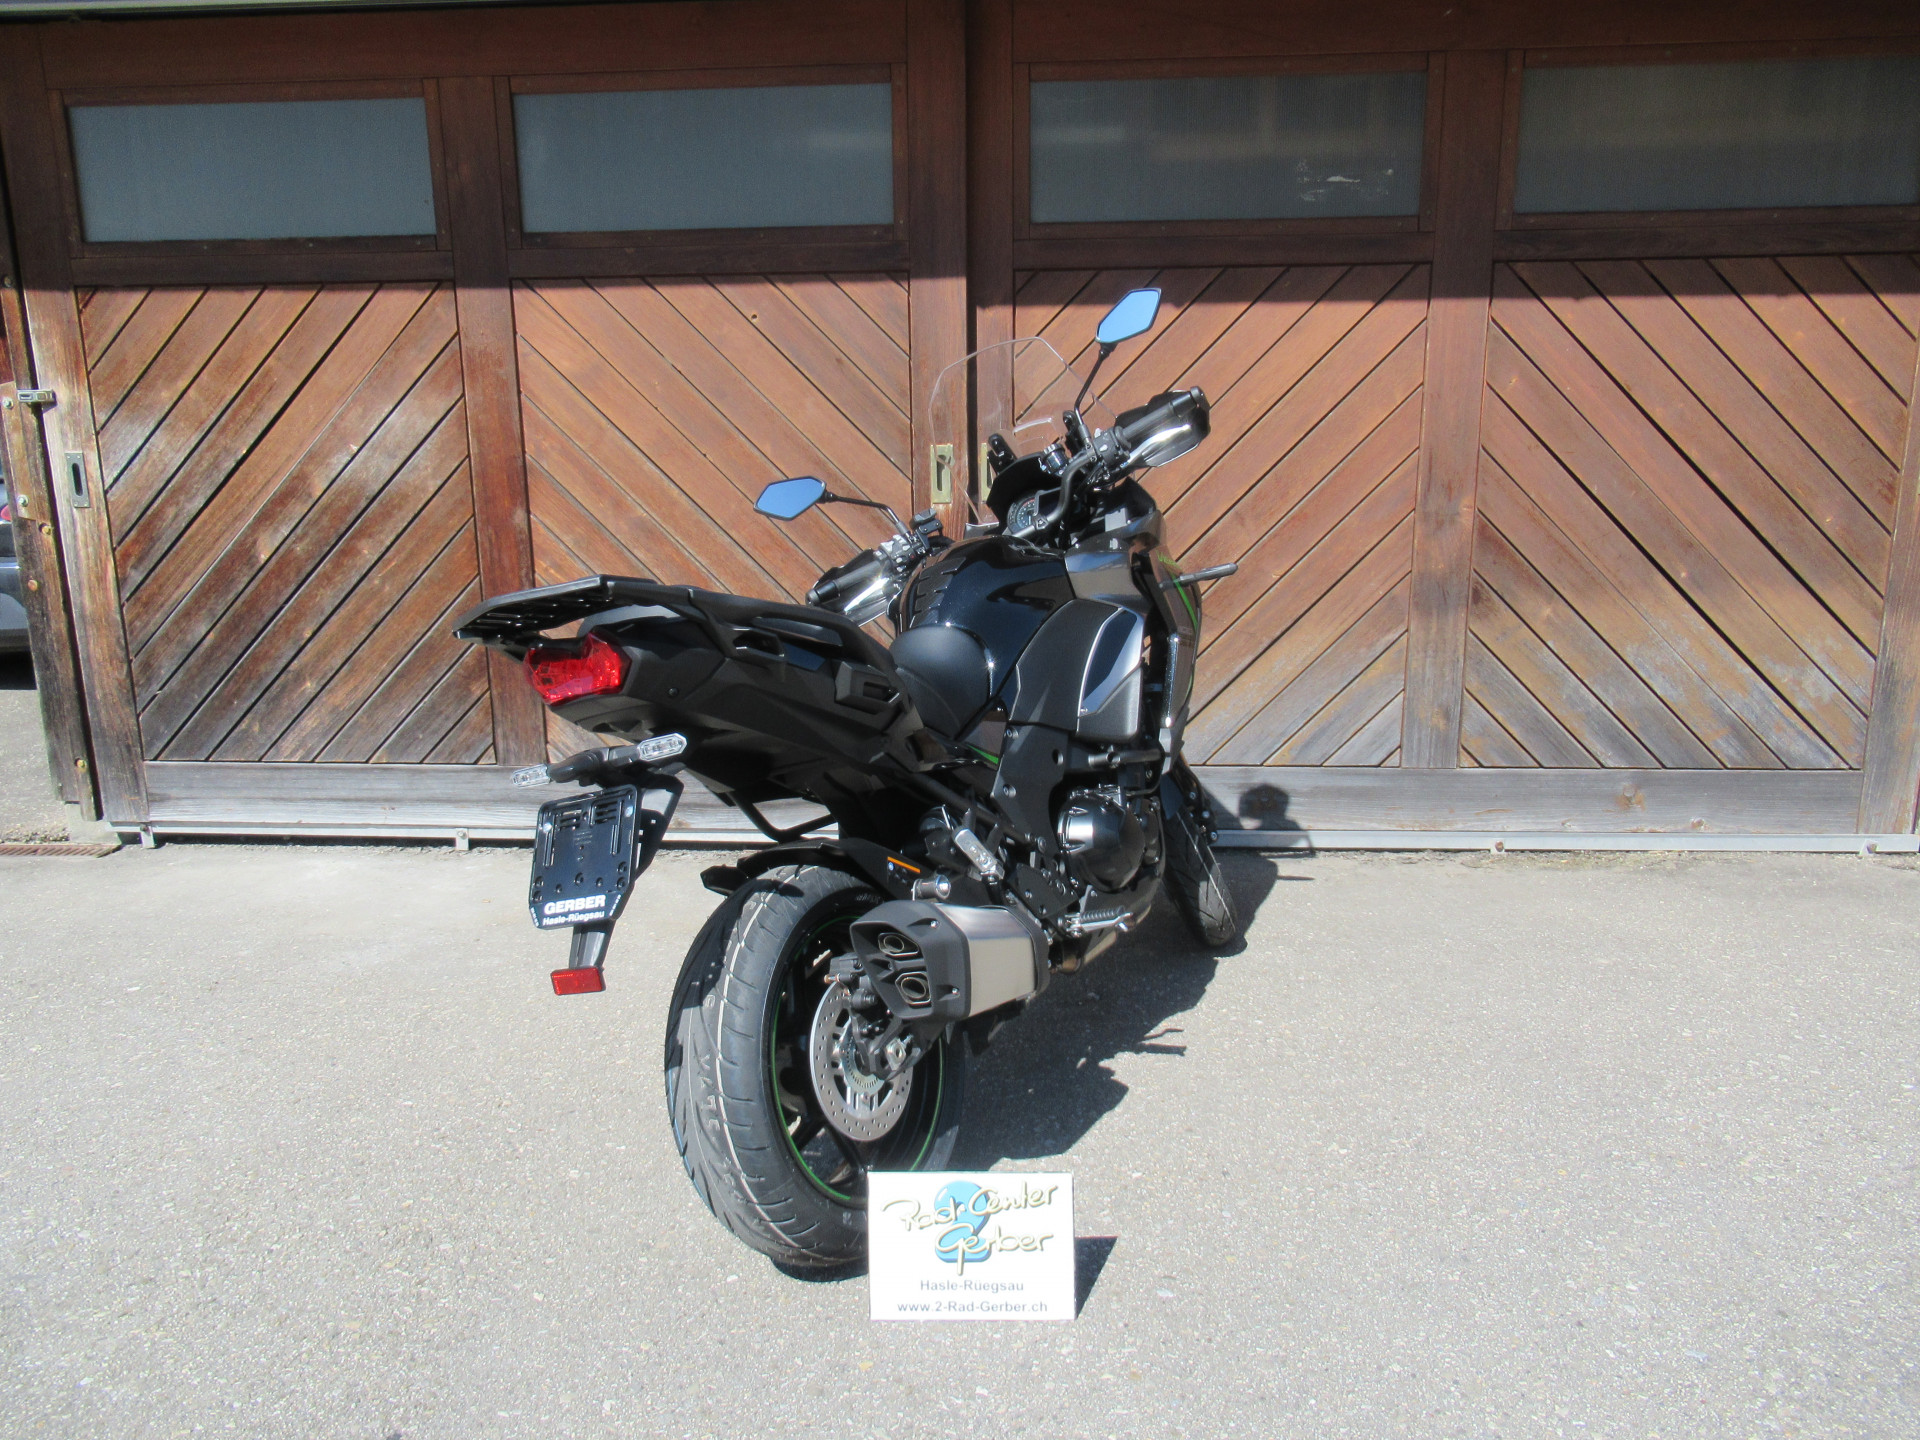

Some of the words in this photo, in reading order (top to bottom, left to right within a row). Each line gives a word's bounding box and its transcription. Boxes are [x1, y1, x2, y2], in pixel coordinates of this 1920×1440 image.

[543, 894, 606, 915] GERBER
[935, 1223, 1054, 1276] Gerber
[919, 1279, 1024, 1295] Hasle-Rüegsau
[897, 1300, 1048, 1312] www.2-Rad-Gerber.ch
